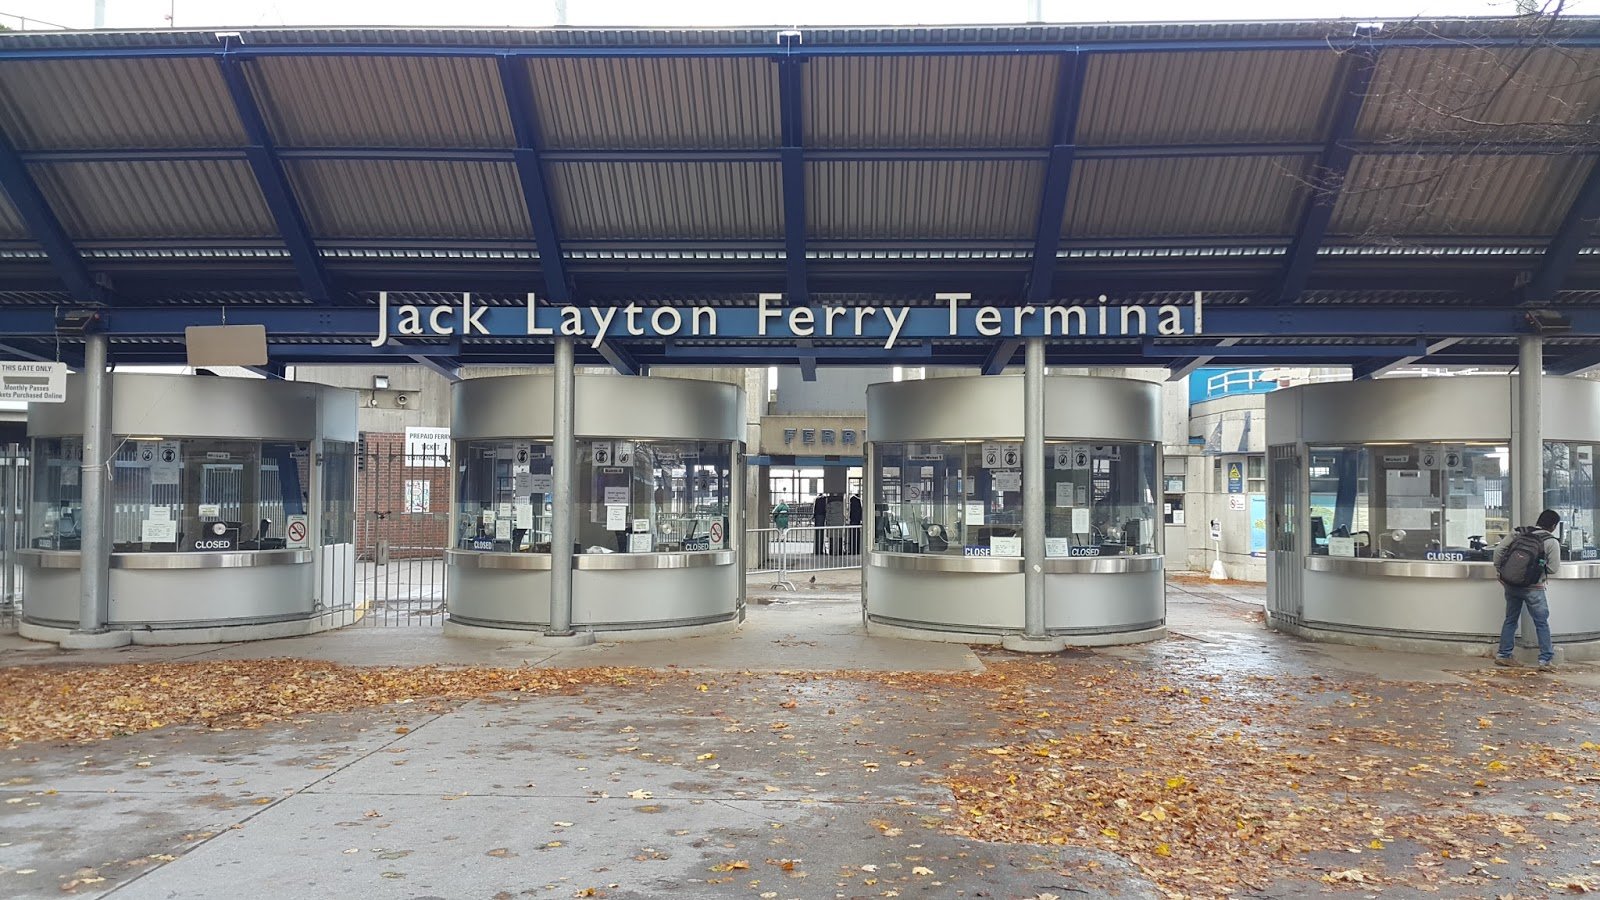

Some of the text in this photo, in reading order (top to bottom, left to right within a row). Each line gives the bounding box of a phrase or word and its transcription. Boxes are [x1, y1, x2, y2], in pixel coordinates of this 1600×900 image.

[371, 291, 1203, 350] Jack Layton Ferry Terminal
[2, 364, 16, 372] THIS
[17, 365, 35, 373] GATE
[4, 384, 49, 392] Monthly Passes
[12, 391, 43, 399] Purchased
[784, 428, 866, 445] FERR
[195, 540, 230, 549] CLOSED
[473, 540, 492, 549] CLOSED
[685, 543, 708, 551] CLOSED
[965, 547, 990, 556] CLOSE
[1071, 548, 1099, 556] CLOSED
[1426, 552, 1463, 561] CLOSED
